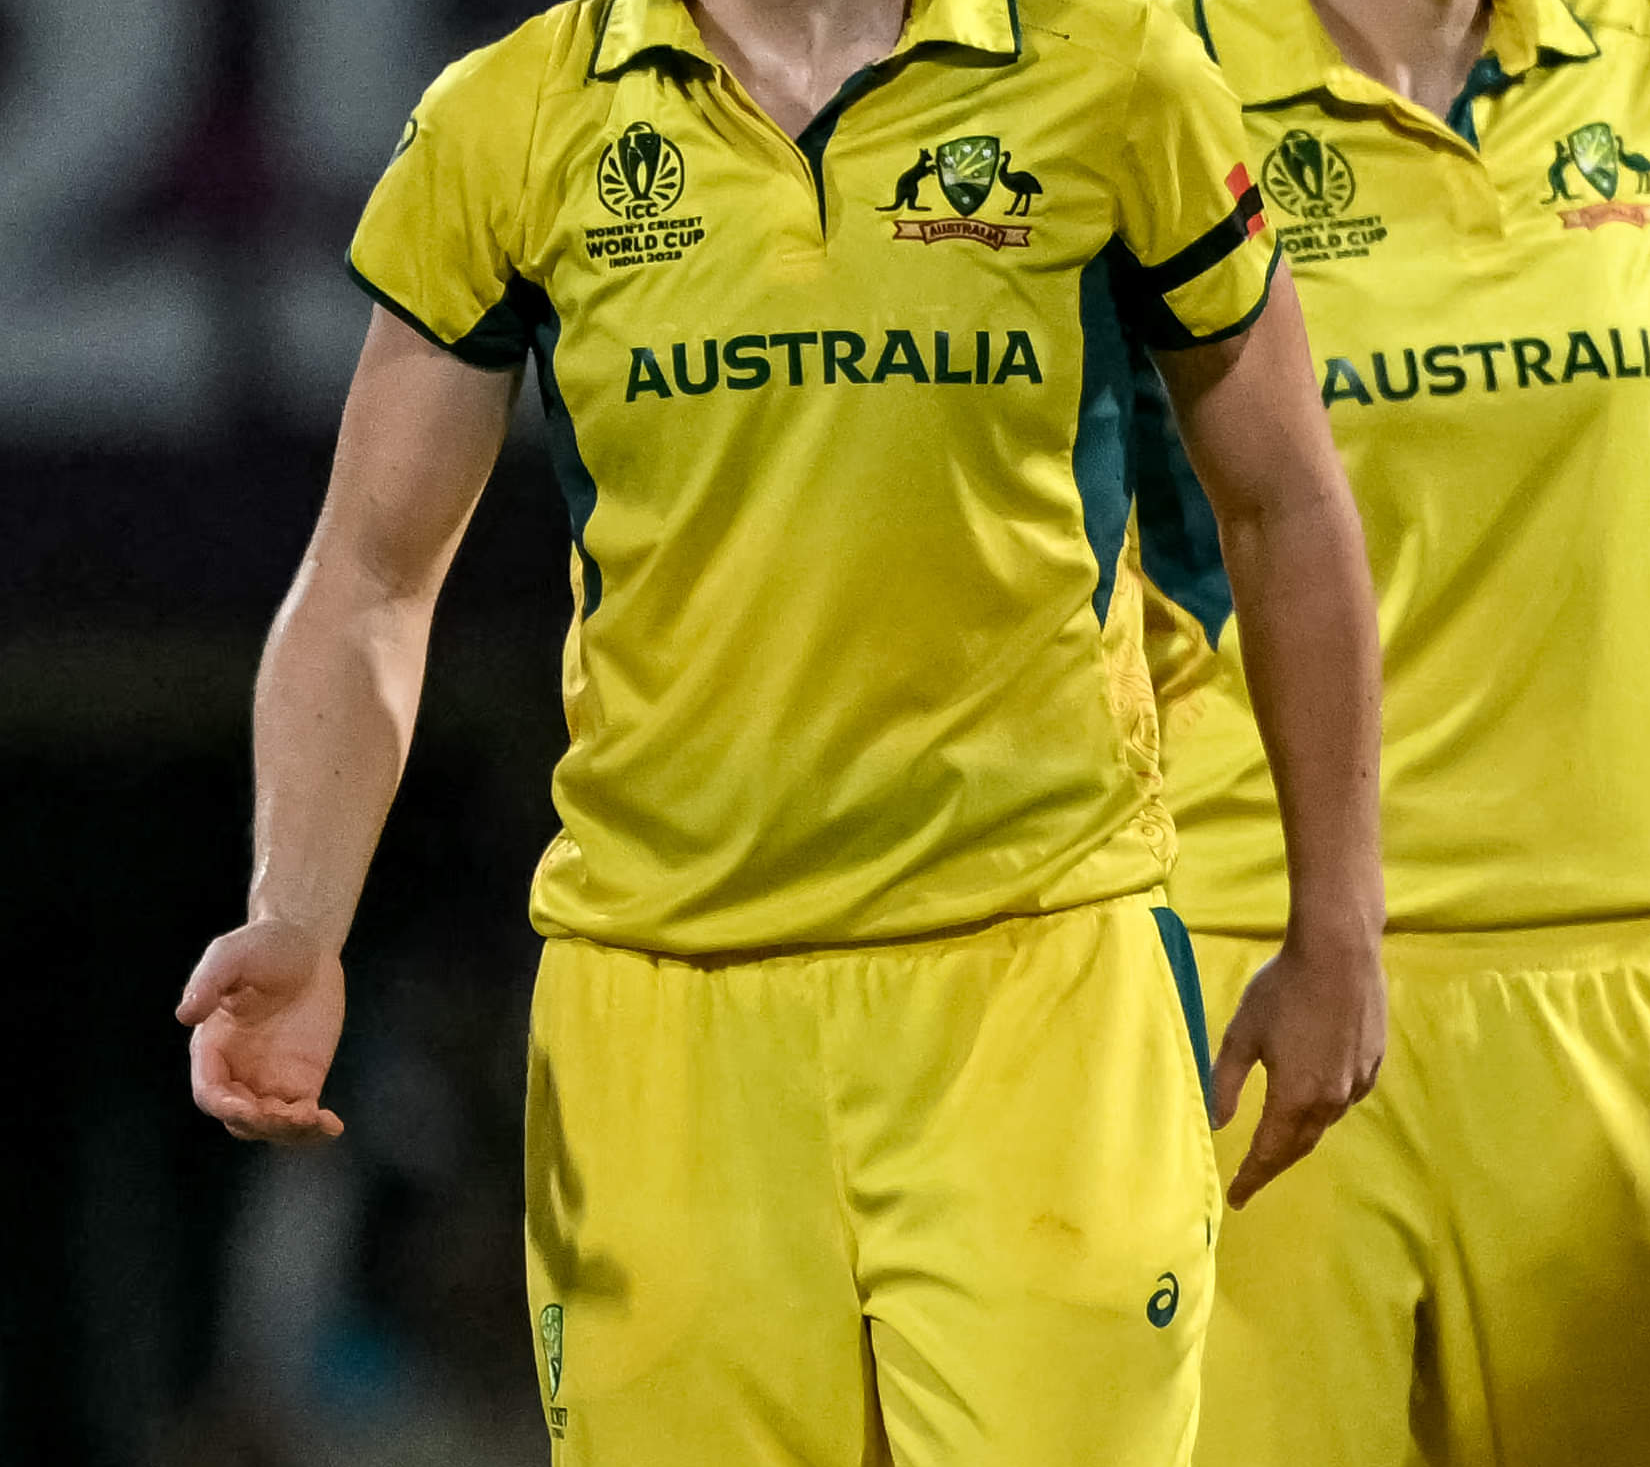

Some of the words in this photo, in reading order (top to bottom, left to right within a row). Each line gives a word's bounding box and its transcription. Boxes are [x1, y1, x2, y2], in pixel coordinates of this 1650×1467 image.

[625, 202, 659, 220] ICC
[648, 216, 702, 231] CRICKET
[929, 222, 1000, 242] AUSTRALIA
[586, 235, 658, 259] WORLD
[663, 229, 705, 248] CUP
[1283, 234, 1341, 253] ORLD
[609, 255, 644, 268] INDIA
[625, 329, 1043, 402] AUSTRALIA
